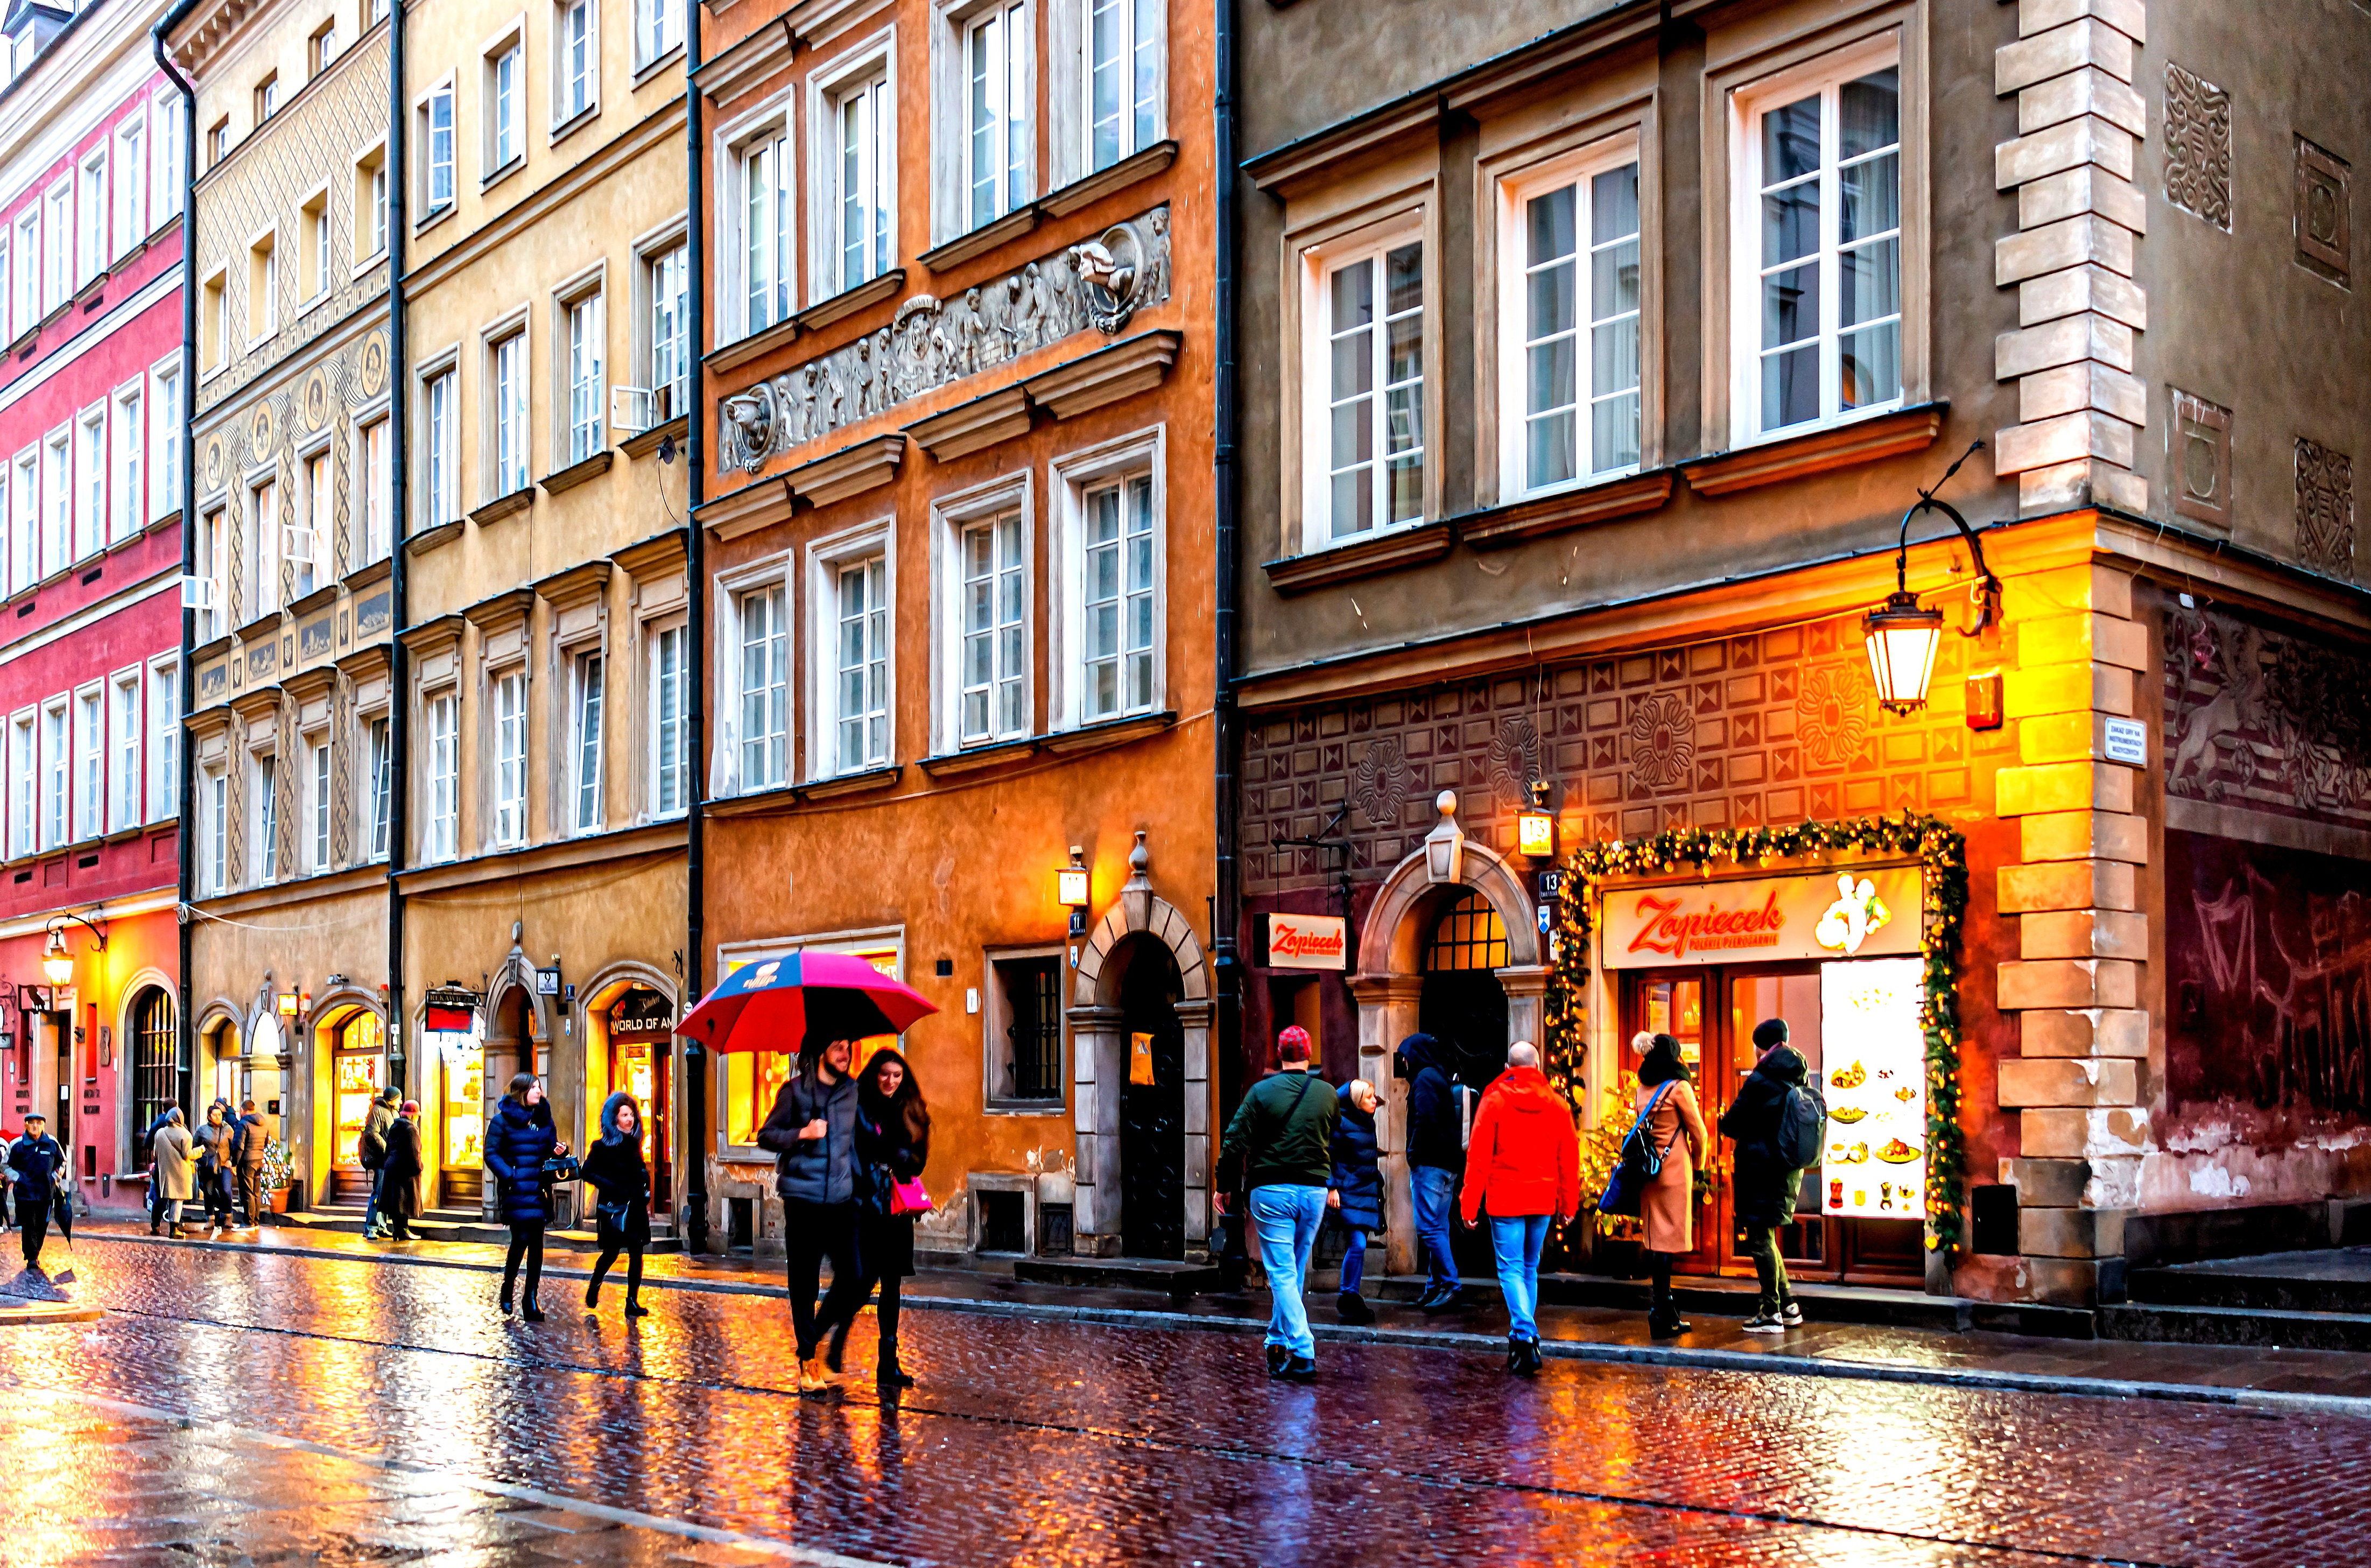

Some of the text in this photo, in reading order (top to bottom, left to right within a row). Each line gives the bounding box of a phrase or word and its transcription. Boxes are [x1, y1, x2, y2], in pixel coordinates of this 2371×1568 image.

[1530, 819, 1545, 838] 13
[1545, 874, 1558, 890] 13
[1073, 915, 1080, 929] 11
[1627, 888, 1786, 958] Zapiecek
[1271, 923, 1343, 958] Zapiecek
[1689, 933, 1779, 951] POLSKIE PIEROGARNIE
[544, 973, 551, 983] 9
[613, 1018, 643, 1031] WORLD
[646, 1017, 658, 1029] OF
